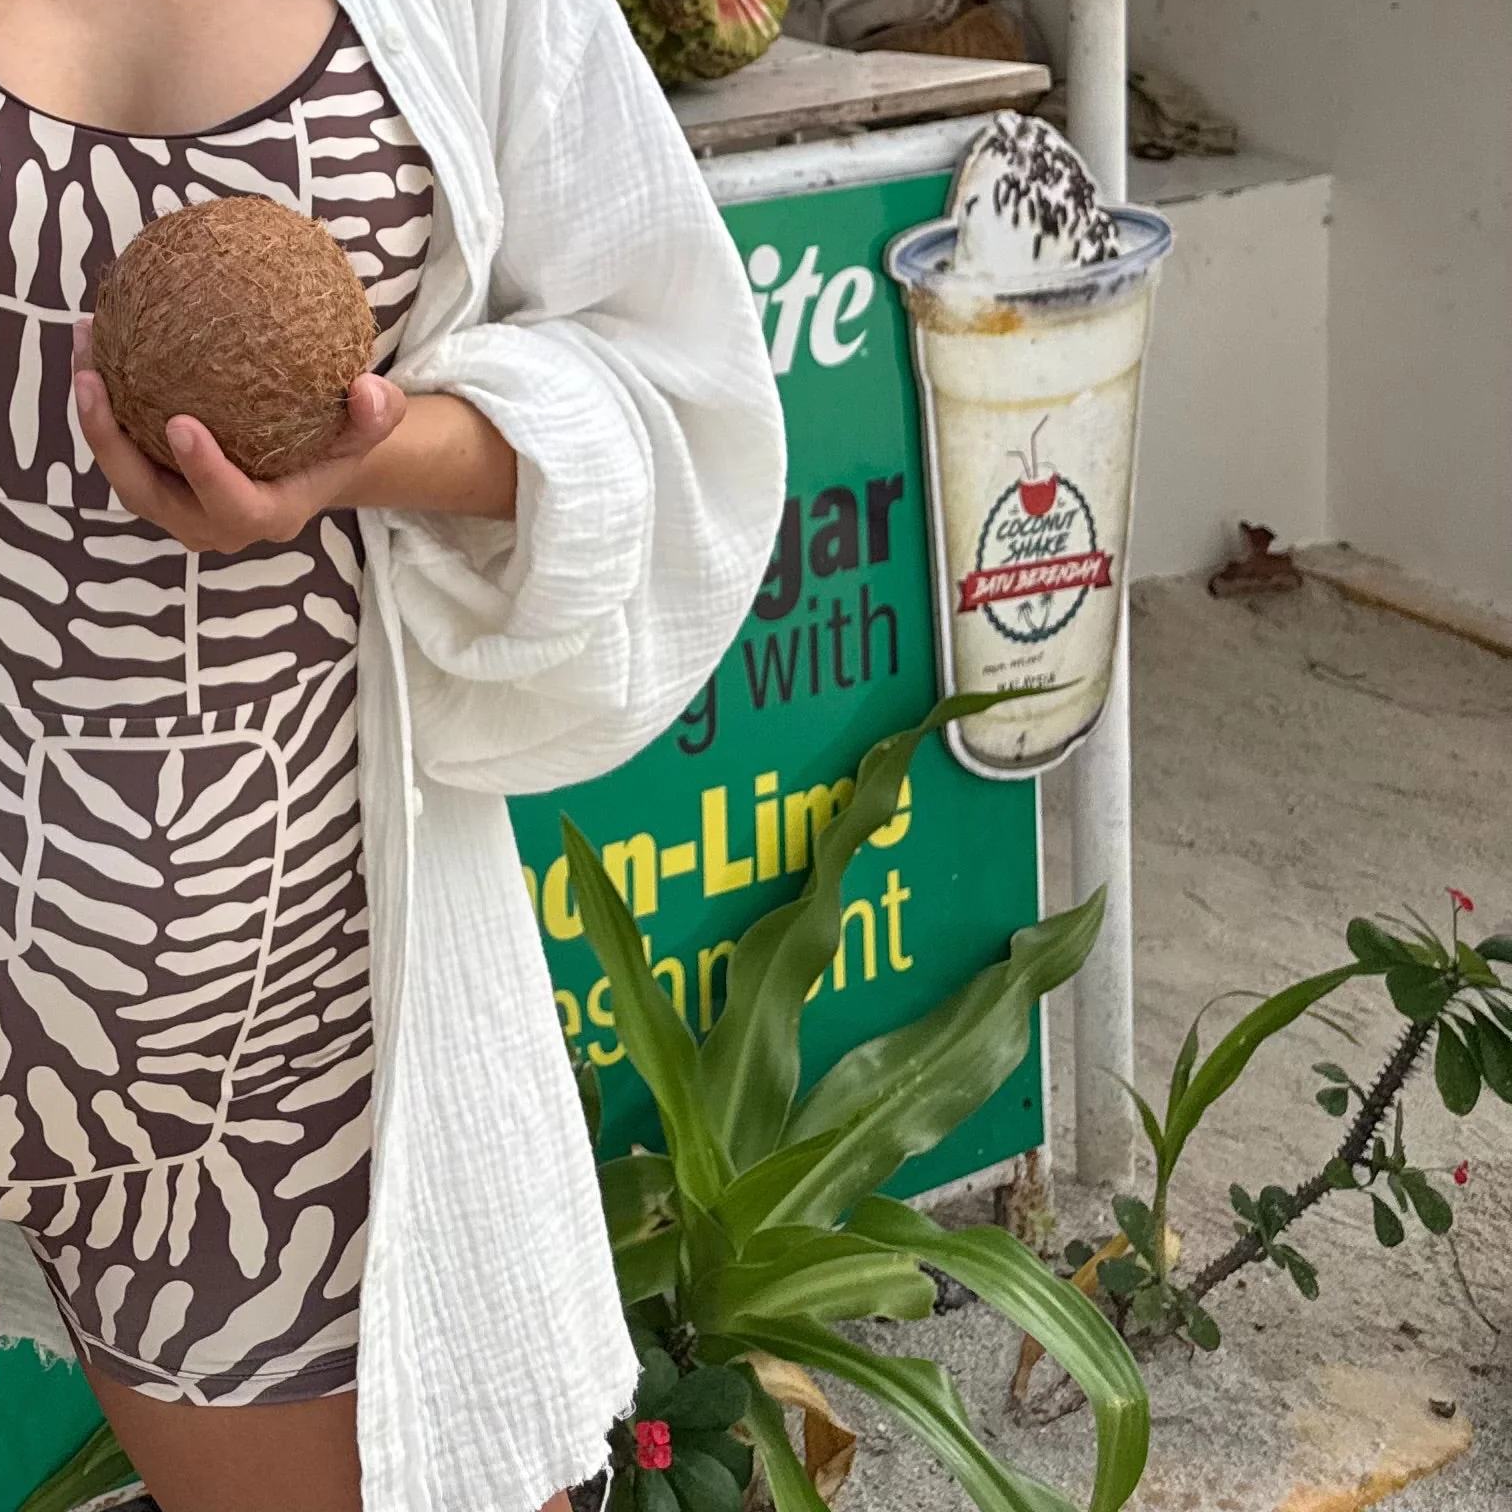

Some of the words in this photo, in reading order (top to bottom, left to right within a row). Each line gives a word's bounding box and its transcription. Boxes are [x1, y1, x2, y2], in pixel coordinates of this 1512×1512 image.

[748, 244, 875, 377] ite
[753, 472, 905, 621] gar
[996, 509, 1080, 541] COCONUT
[1001, 531, 1070, 564] SHAKE
[742, 584, 900, 710] with
